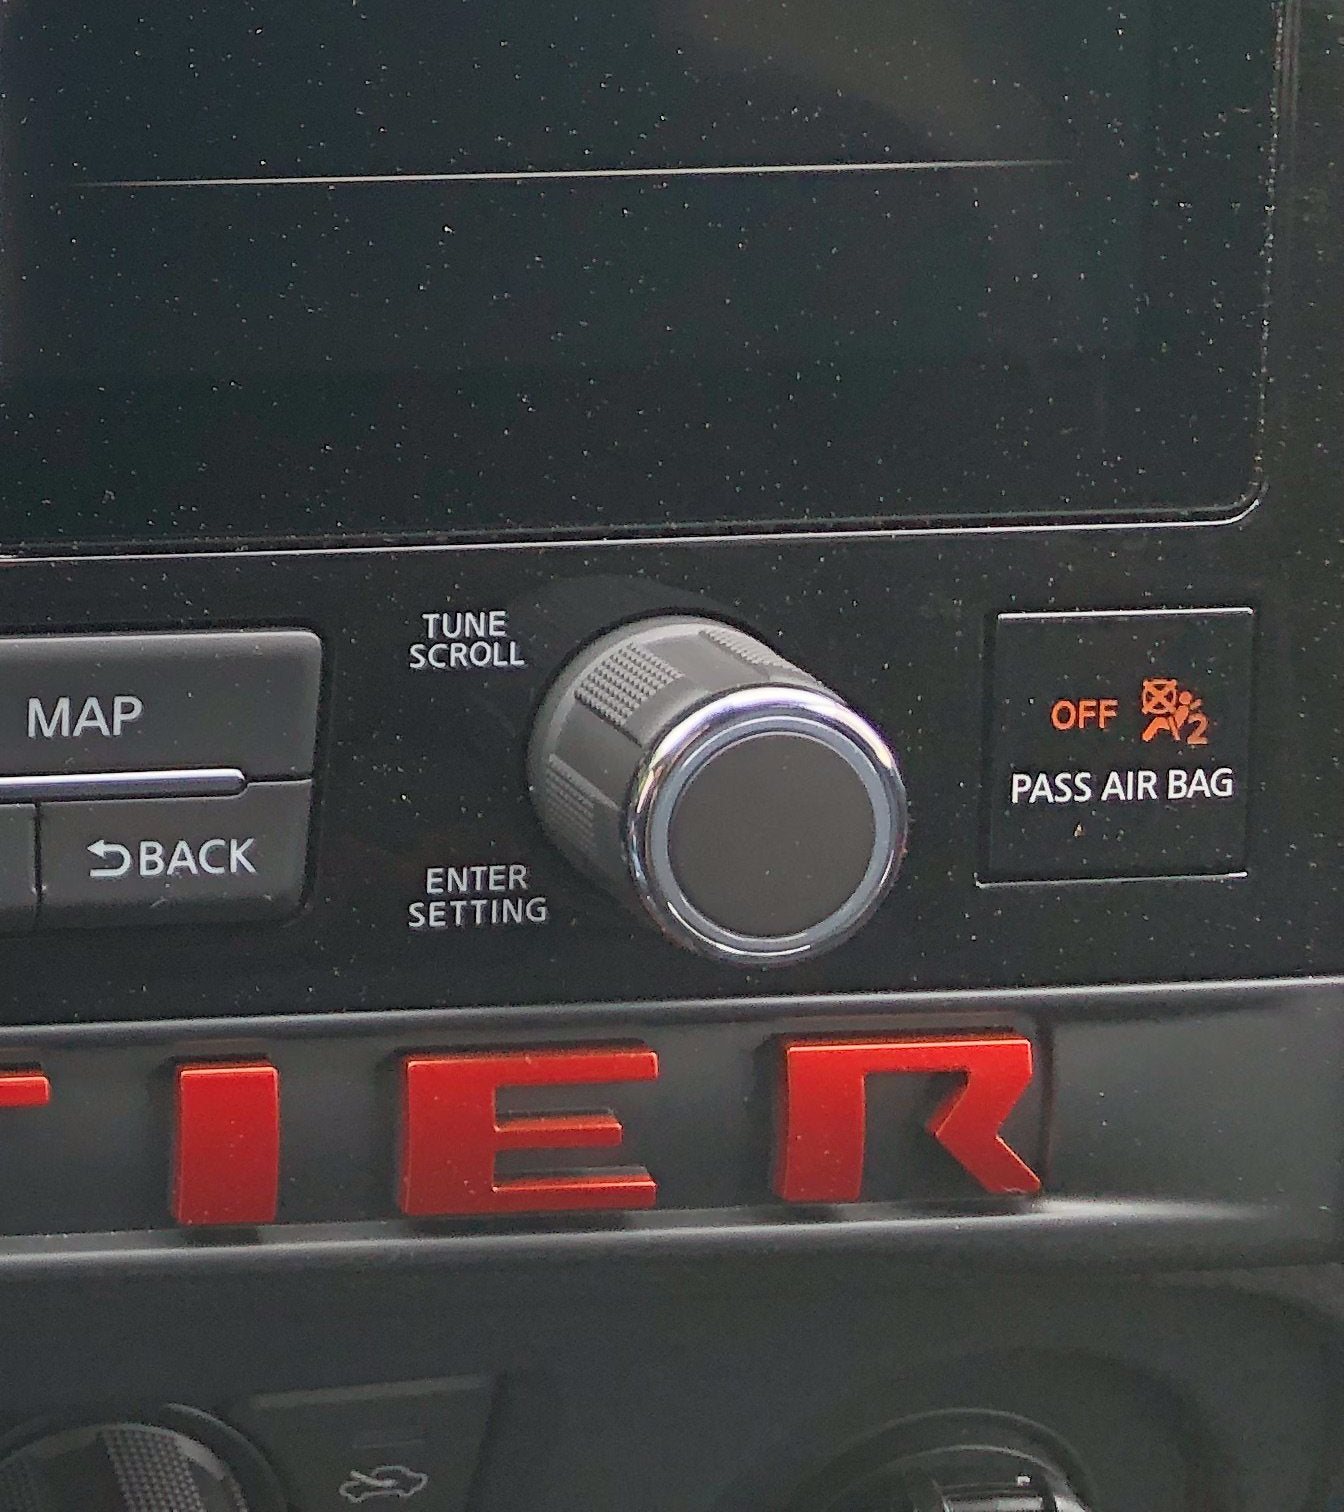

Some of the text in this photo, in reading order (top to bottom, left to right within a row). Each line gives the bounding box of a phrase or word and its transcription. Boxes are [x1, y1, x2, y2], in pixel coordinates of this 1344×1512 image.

[422, 610, 508, 639] TUNE
[409, 640, 525, 669] SCROLL
[26, 696, 144, 740] MAP
[1050, 699, 1118, 731] OFF
[1011, 767, 1233, 804] PASS AIR BAG
[139, 838, 256, 879] BACK
[426, 863, 529, 895] ENTER
[408, 897, 548, 928] SETTING
